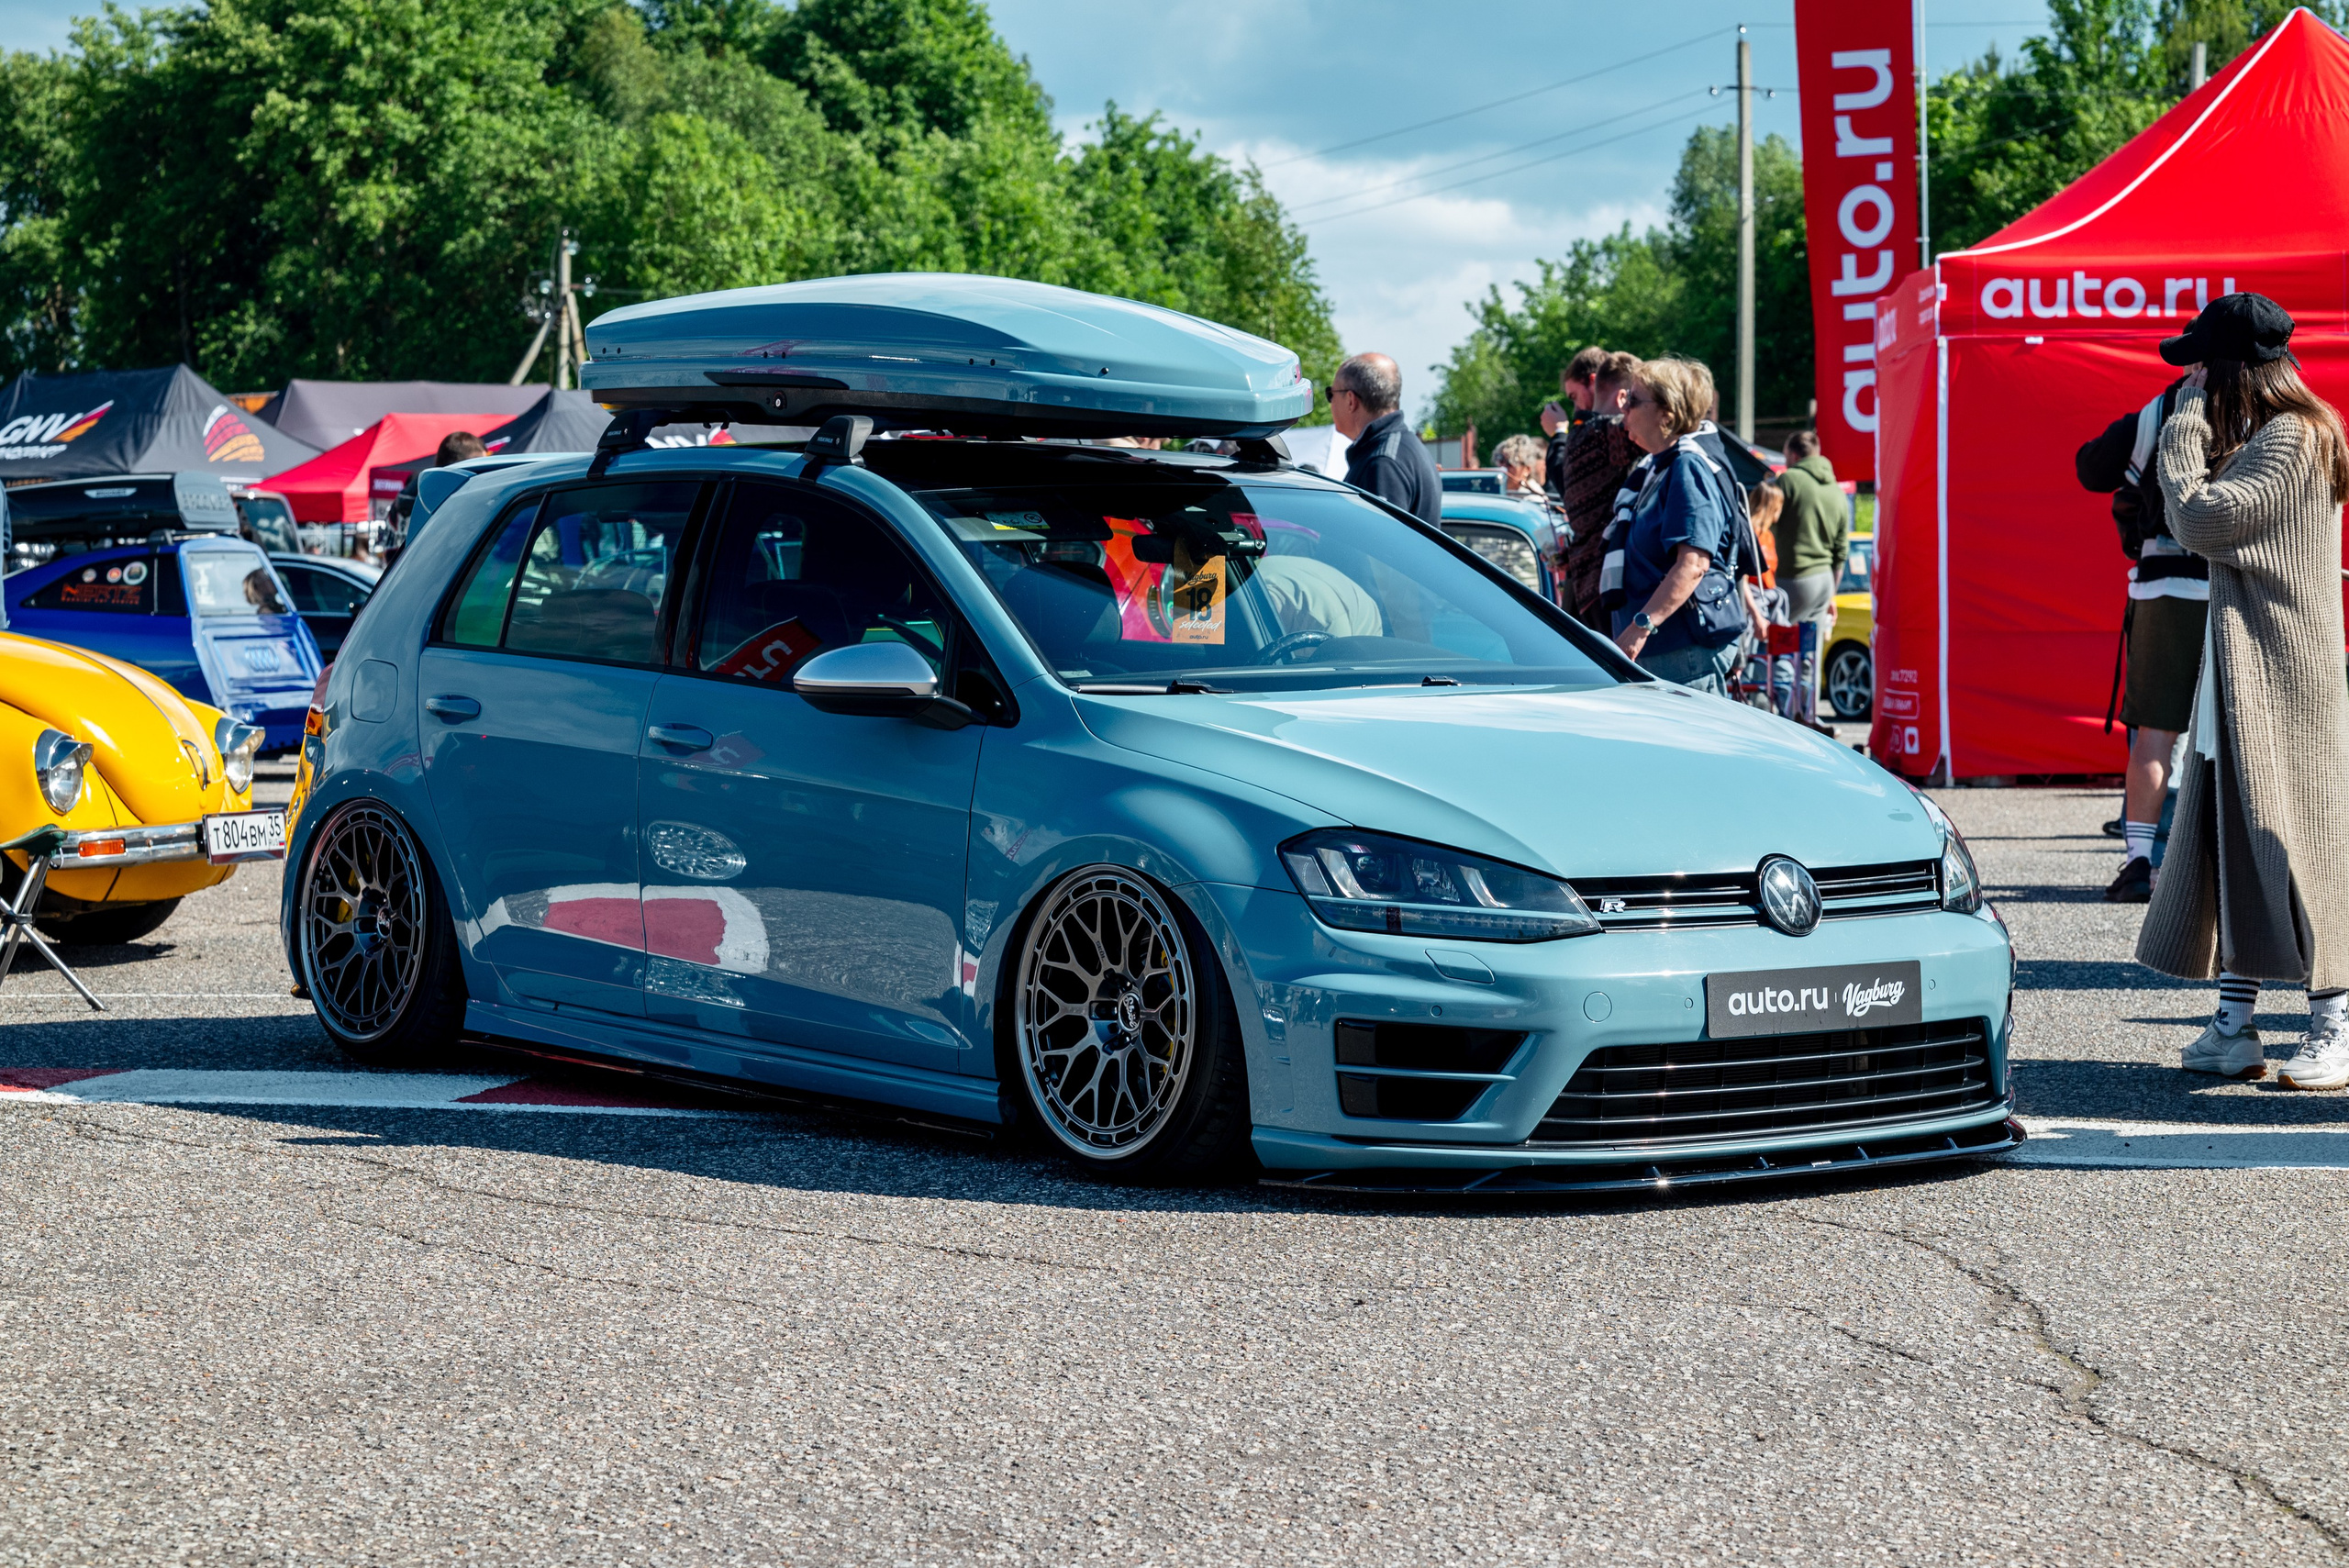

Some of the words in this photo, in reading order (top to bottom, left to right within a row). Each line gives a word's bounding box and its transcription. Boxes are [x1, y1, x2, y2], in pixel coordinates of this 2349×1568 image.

[1186, 587, 1212, 622] 18
[1179, 617, 1222, 631] selected
[268, 816, 281, 837] 35
[1728, 986, 1829, 1016] auto.ru
[1842, 977, 1905, 1017] Vagburg
